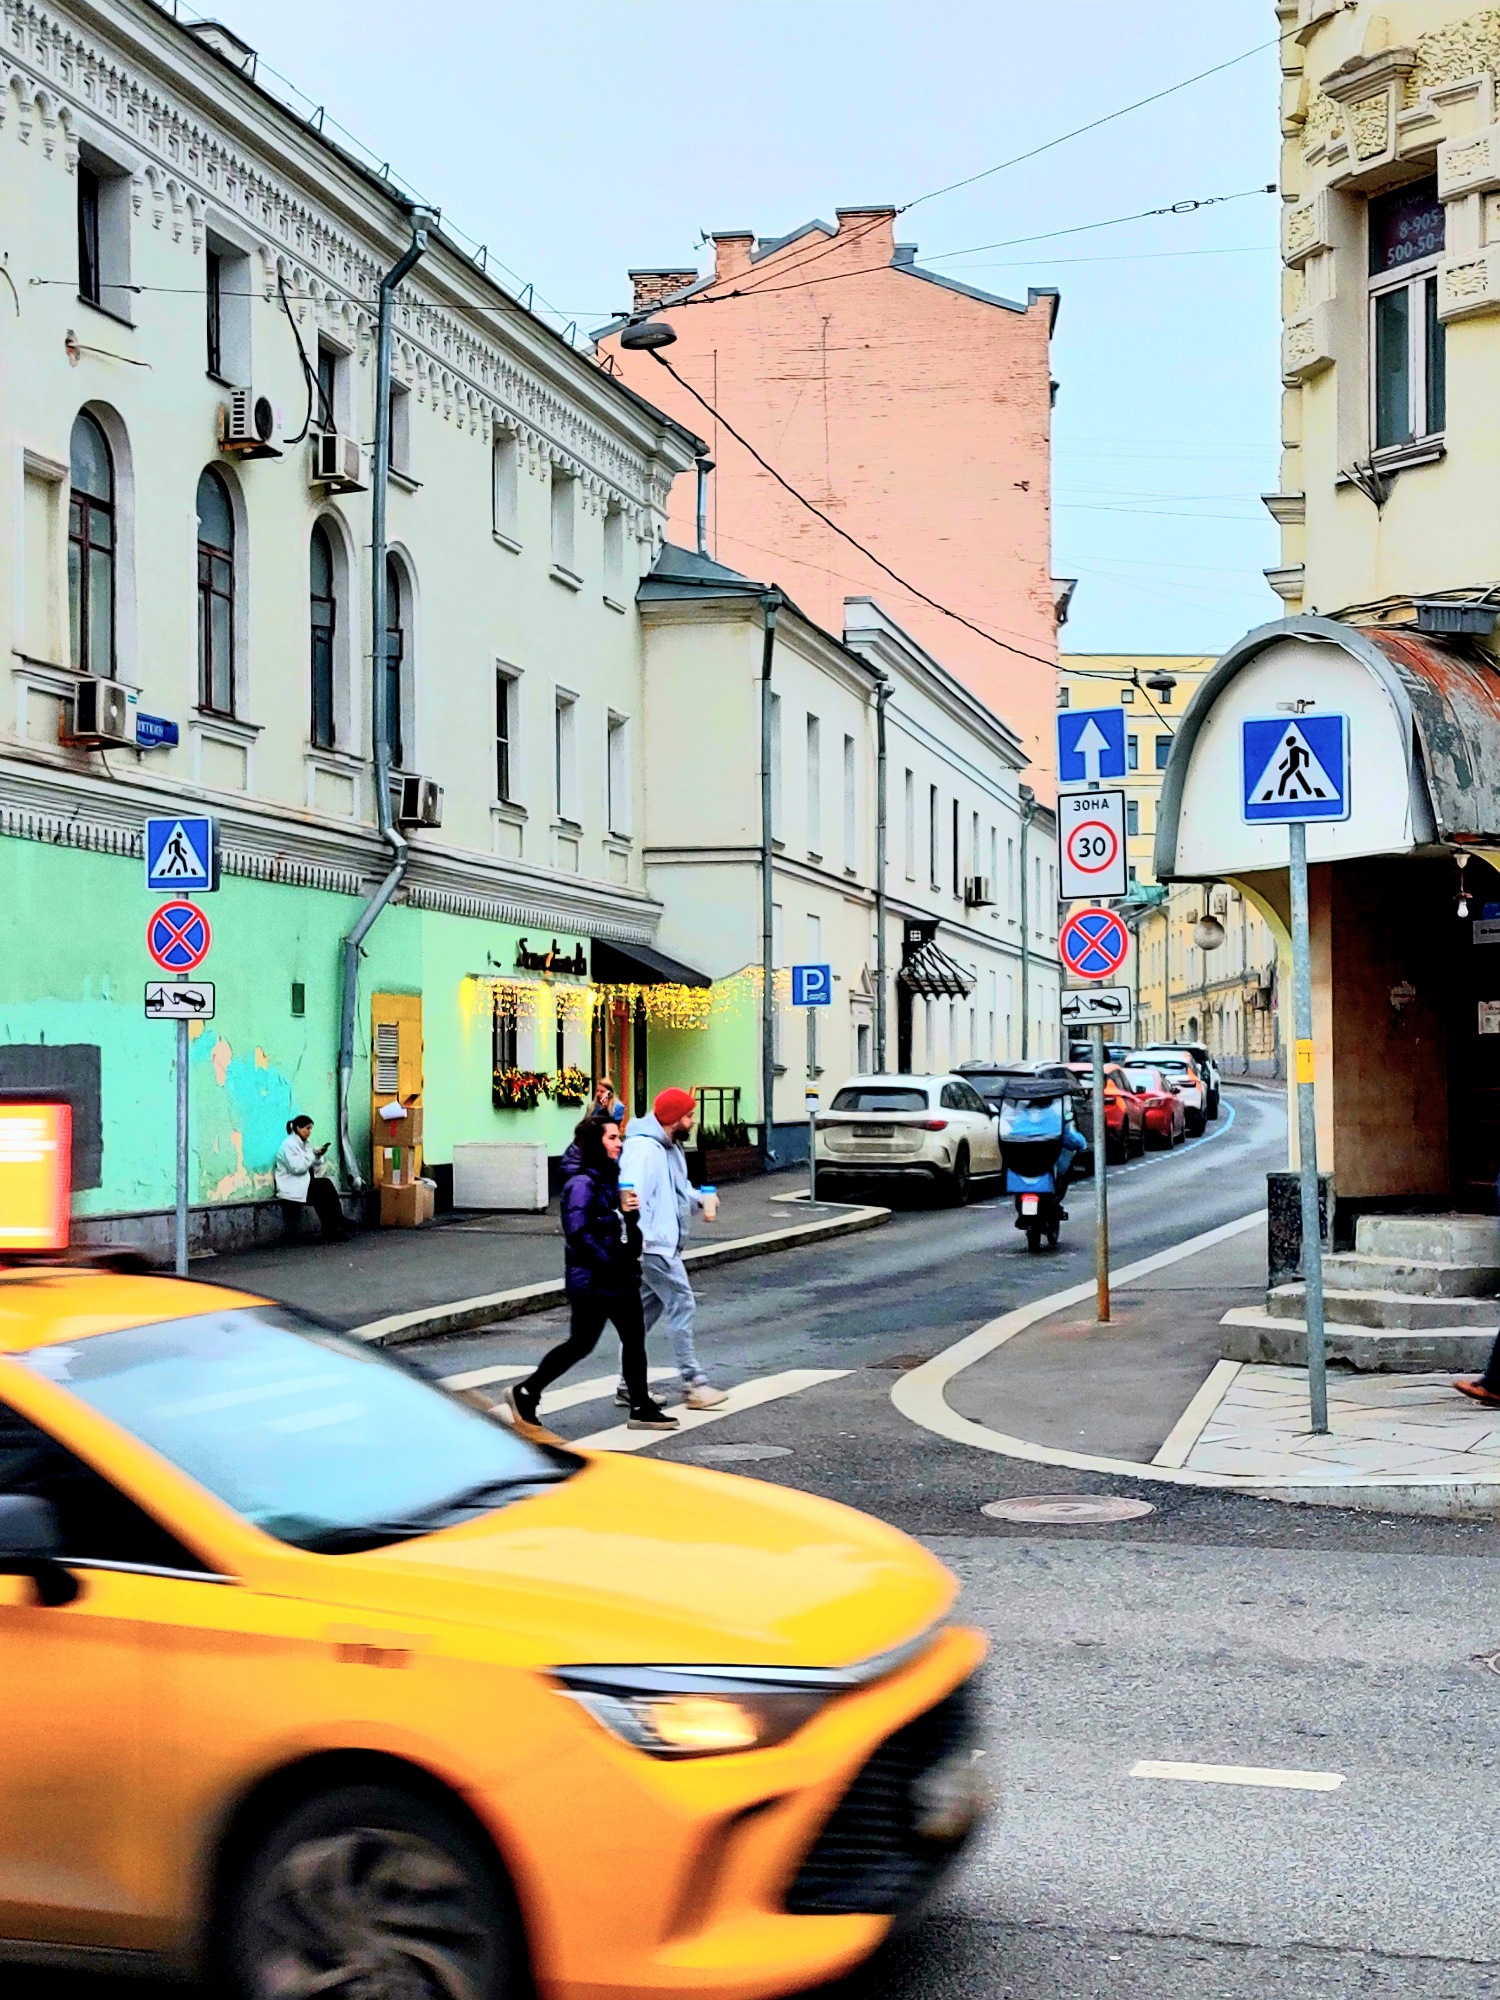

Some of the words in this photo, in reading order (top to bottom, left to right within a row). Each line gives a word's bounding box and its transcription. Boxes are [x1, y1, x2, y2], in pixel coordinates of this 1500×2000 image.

[1073, 799, 1110, 811] ЗОНА
[1079, 837, 1106, 858] 30
[802, 969, 824, 1001] P
